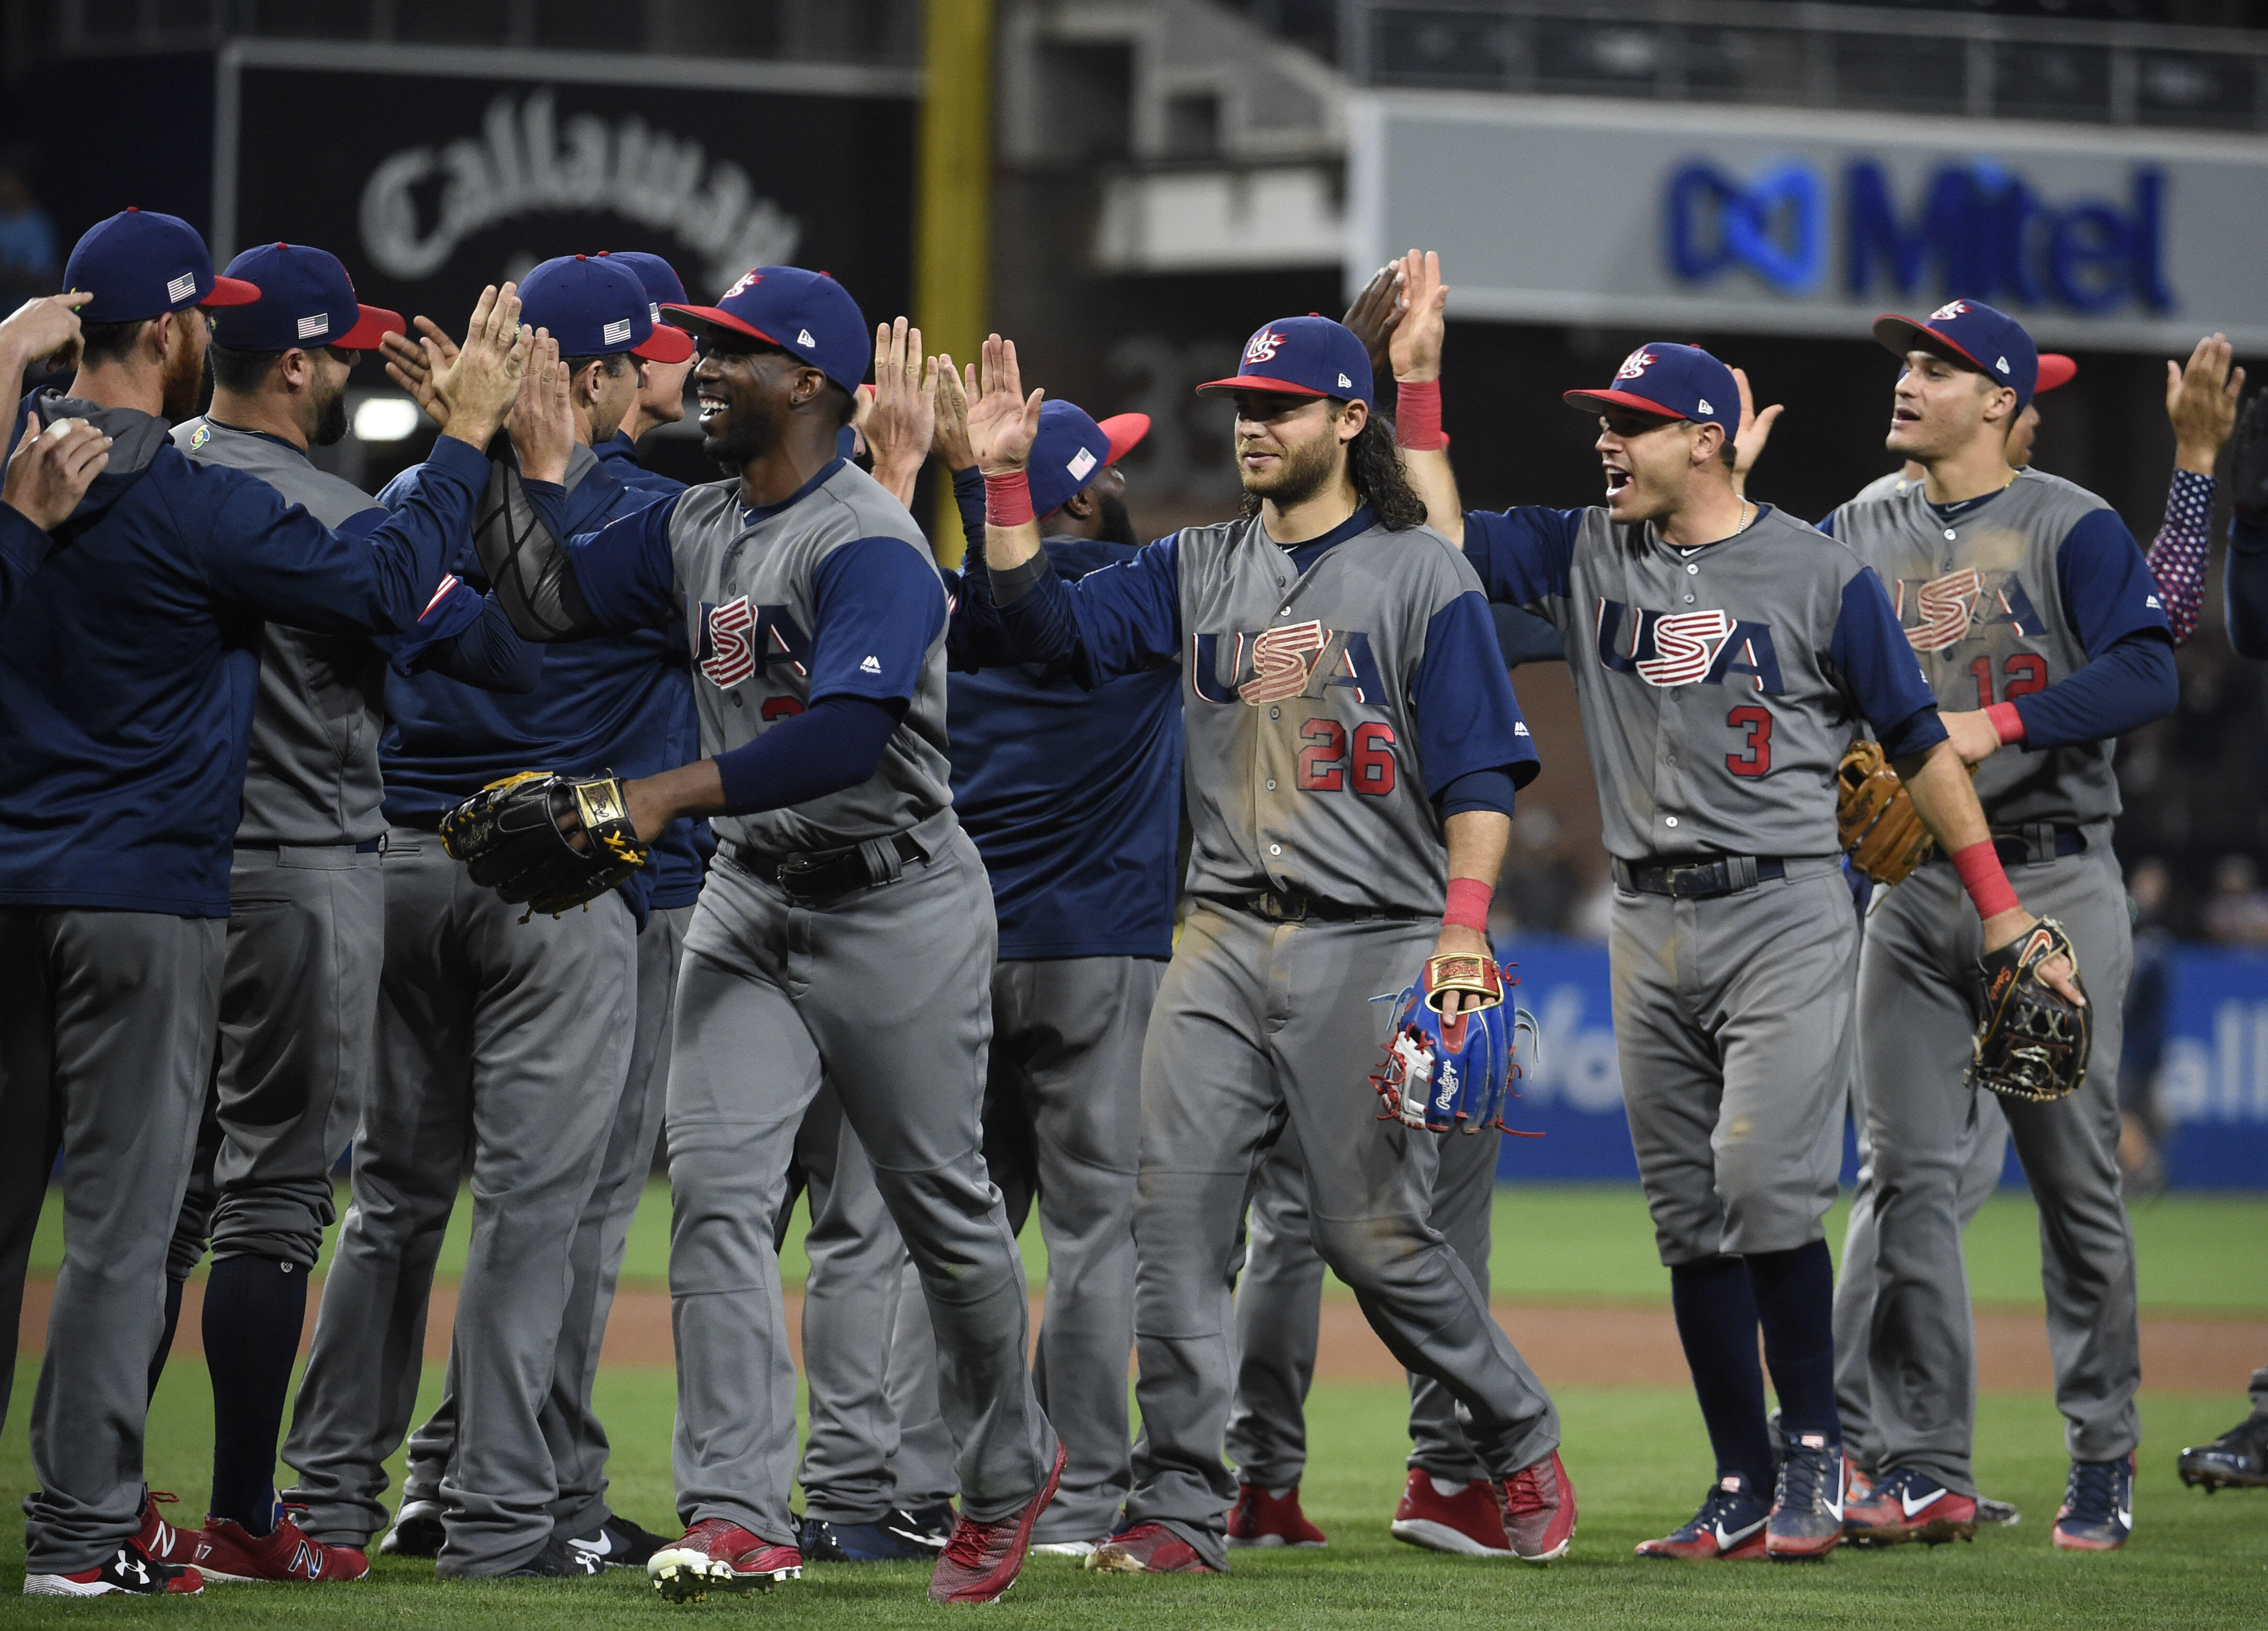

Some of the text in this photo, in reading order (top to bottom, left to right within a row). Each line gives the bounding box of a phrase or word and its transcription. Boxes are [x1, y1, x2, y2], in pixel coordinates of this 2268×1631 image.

[357, 84, 802, 300] Callaway
[1844, 155, 2171, 313] Mitel
[1192, 619, 1390, 706] USA
[1596, 597, 1785, 696] USA
[1970, 654, 2047, 709] 12
[1297, 717, 1395, 797] 26
[1726, 705, 1772, 777] 3
[1435, 1059, 1457, 1110] Rawlings
[195, 1543, 213, 1560] 17
